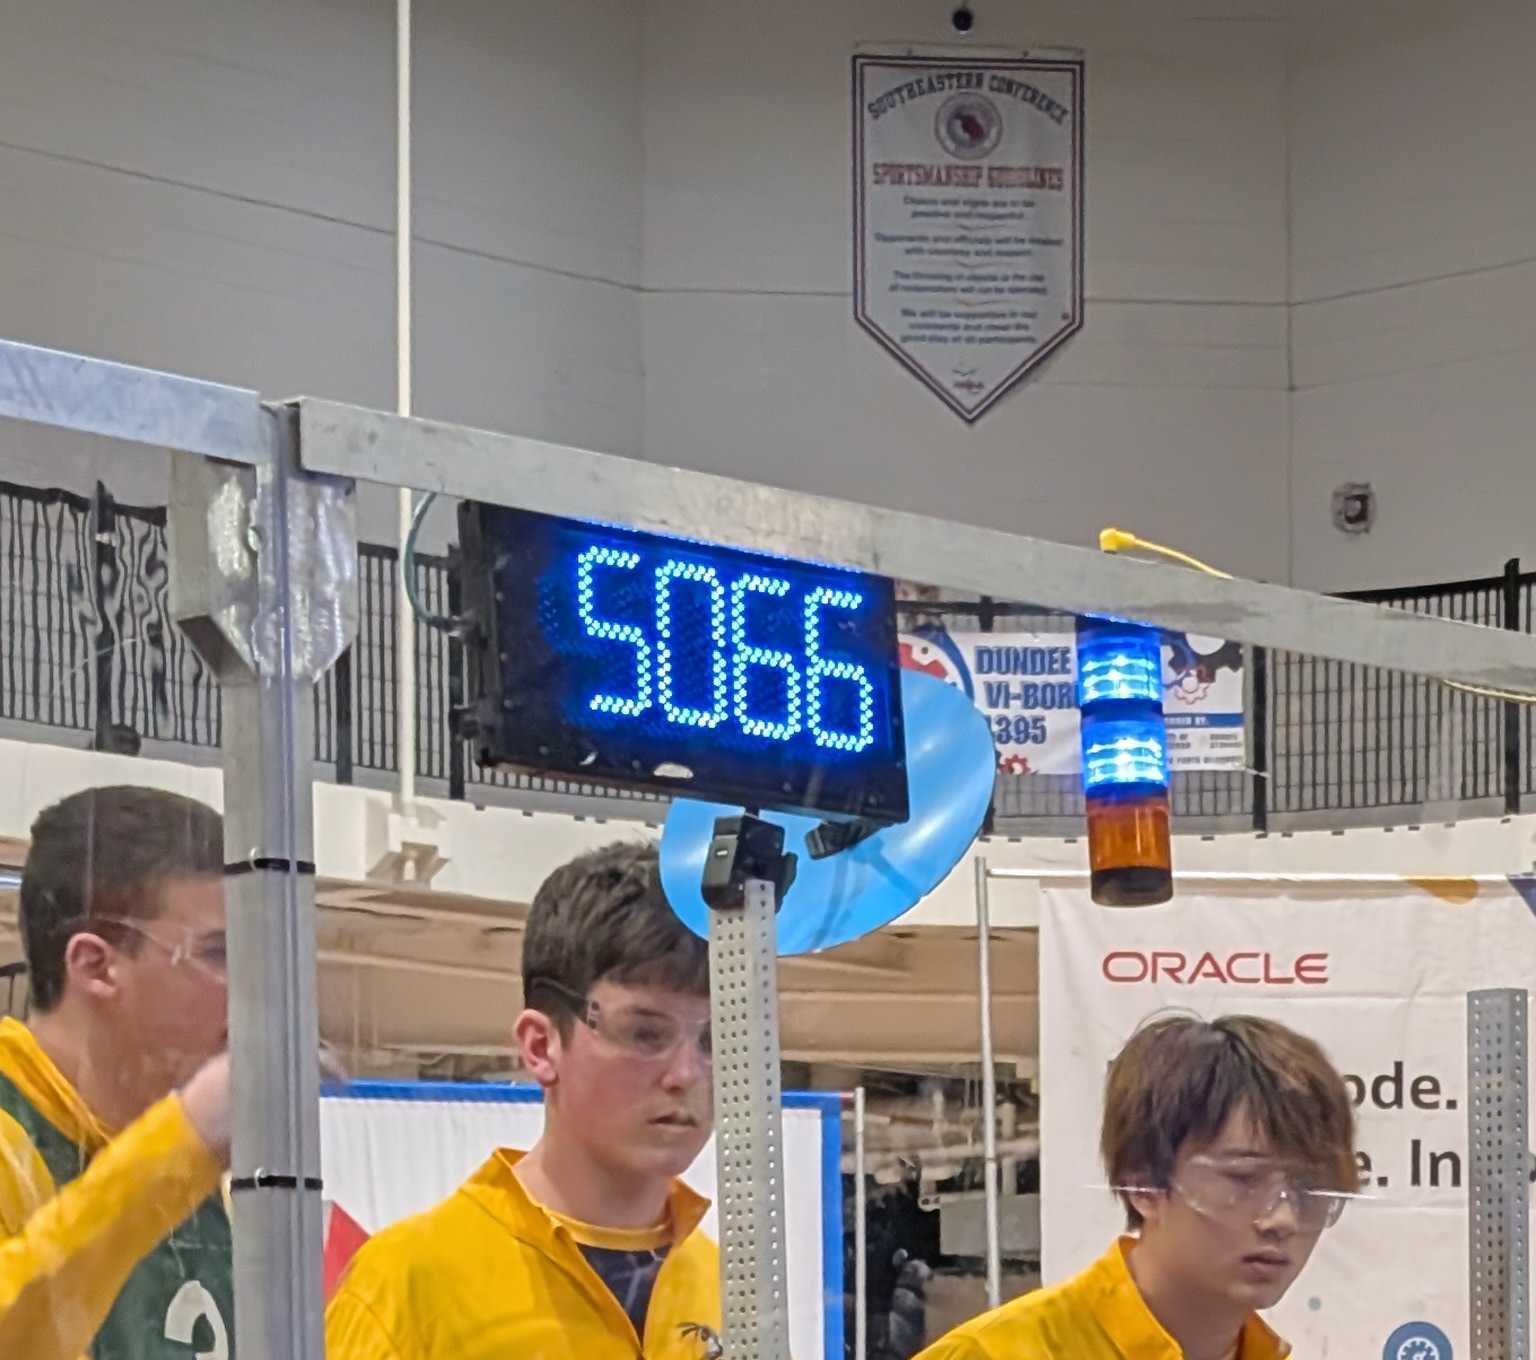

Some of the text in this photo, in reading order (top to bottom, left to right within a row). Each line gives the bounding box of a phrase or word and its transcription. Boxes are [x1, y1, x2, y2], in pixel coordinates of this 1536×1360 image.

[867, 72, 1070, 125] SOUTHEASTERN CONFERENCE
[577, 545, 874, 752] 5066
[975, 646, 1072, 675] DUNDEE
[988, 715, 1047, 745] 395
[1102, 951, 1329, 985] ORACLE
[1345, 1061, 1458, 1110] ode.
